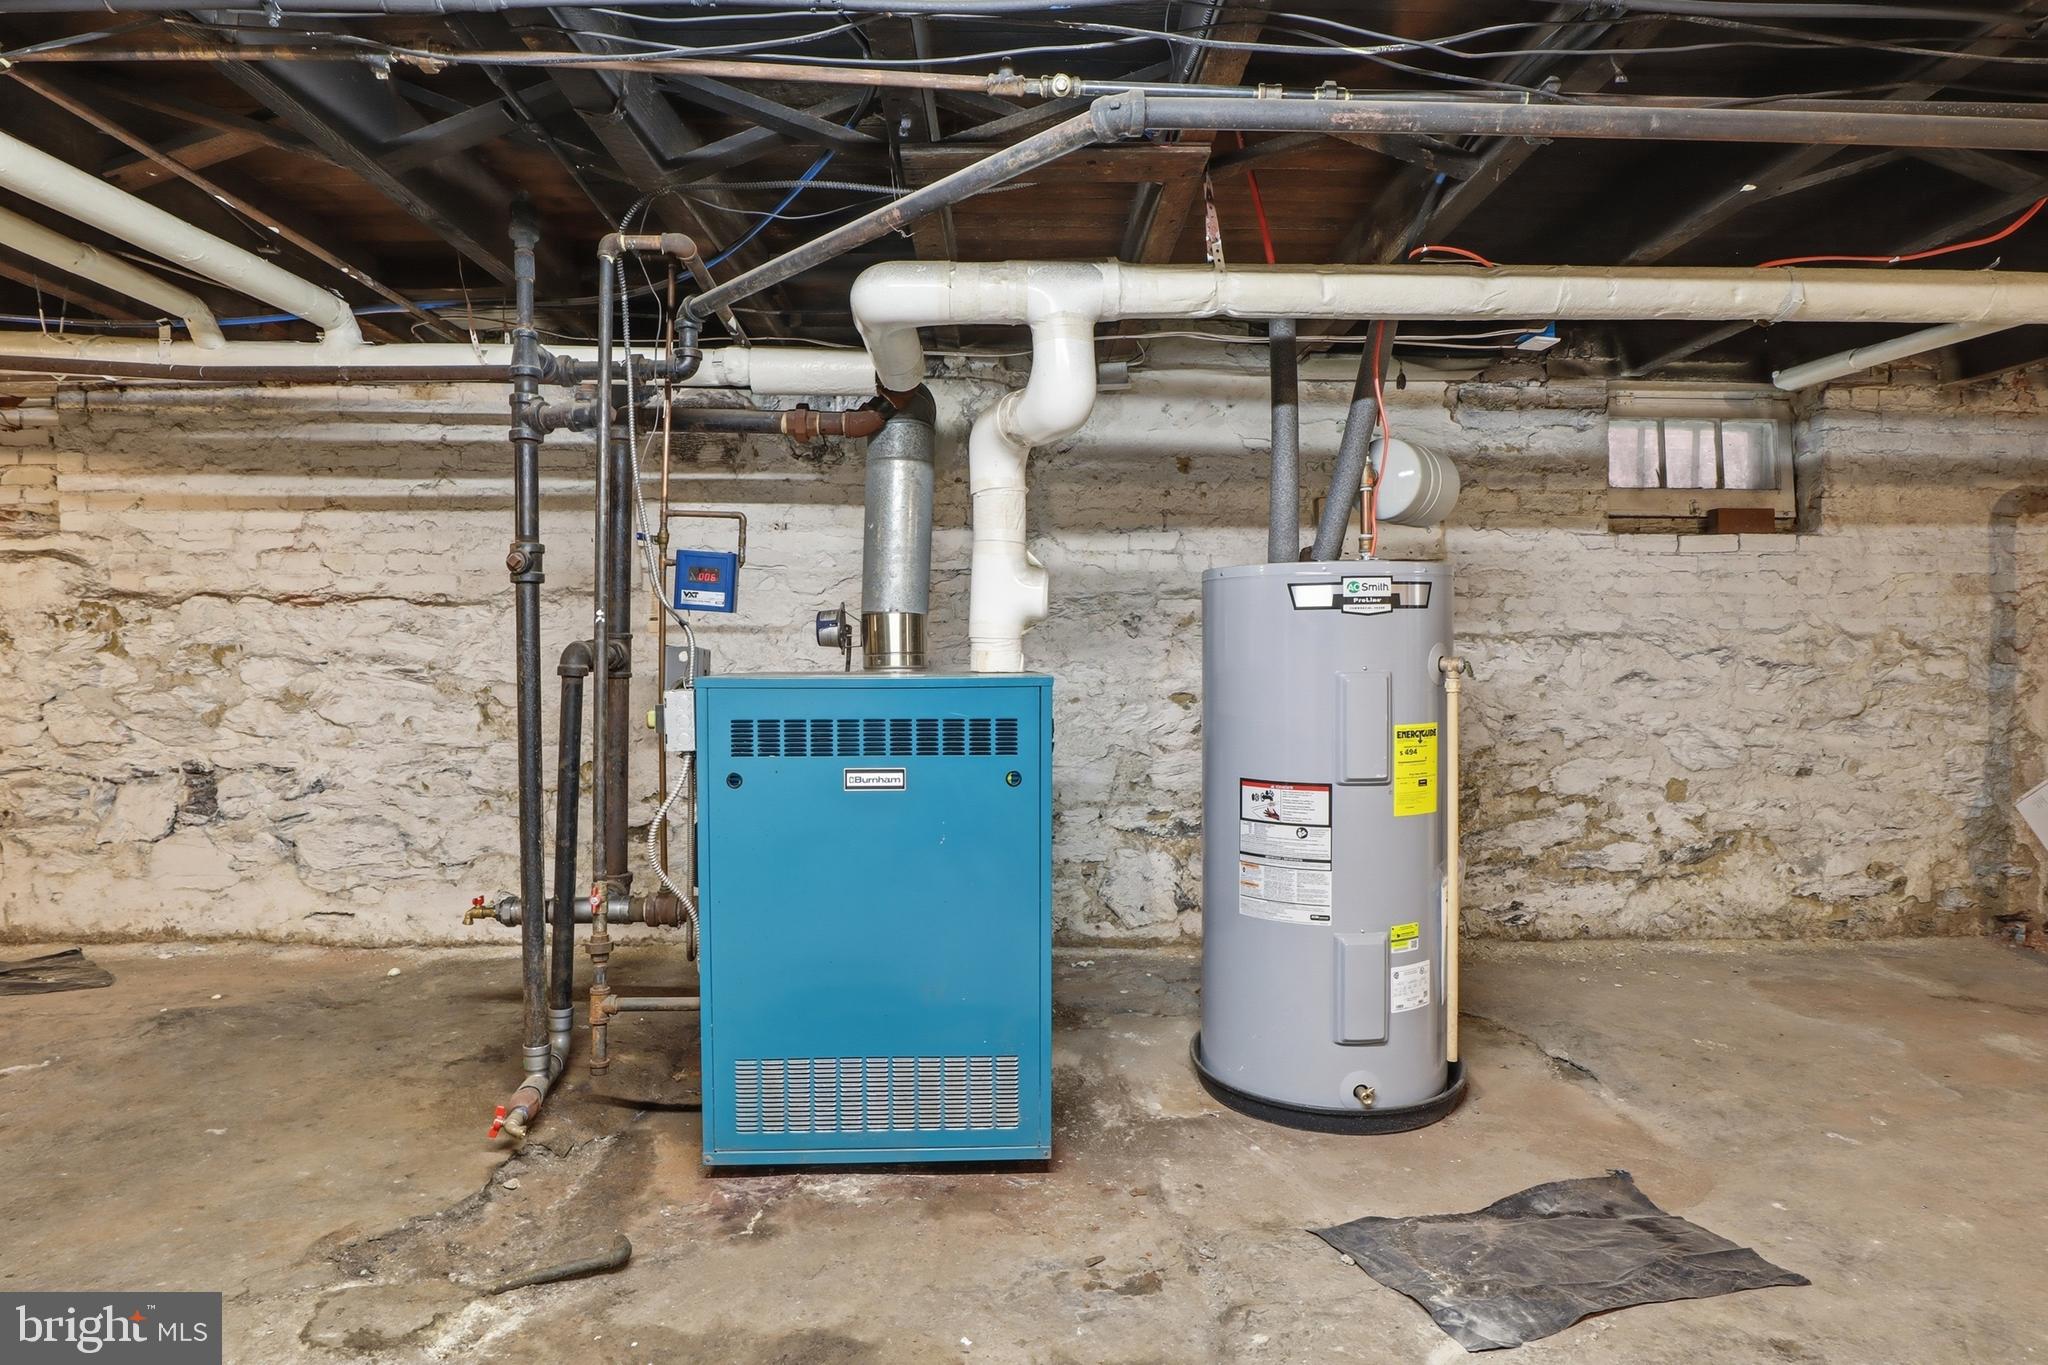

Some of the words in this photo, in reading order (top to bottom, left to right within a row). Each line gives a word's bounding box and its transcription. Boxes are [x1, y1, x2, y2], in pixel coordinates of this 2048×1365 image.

[698, 572, 717, 582] 006
[1361, 582, 1389, 592] Smith
[853, 775, 901, 784] Burnham
